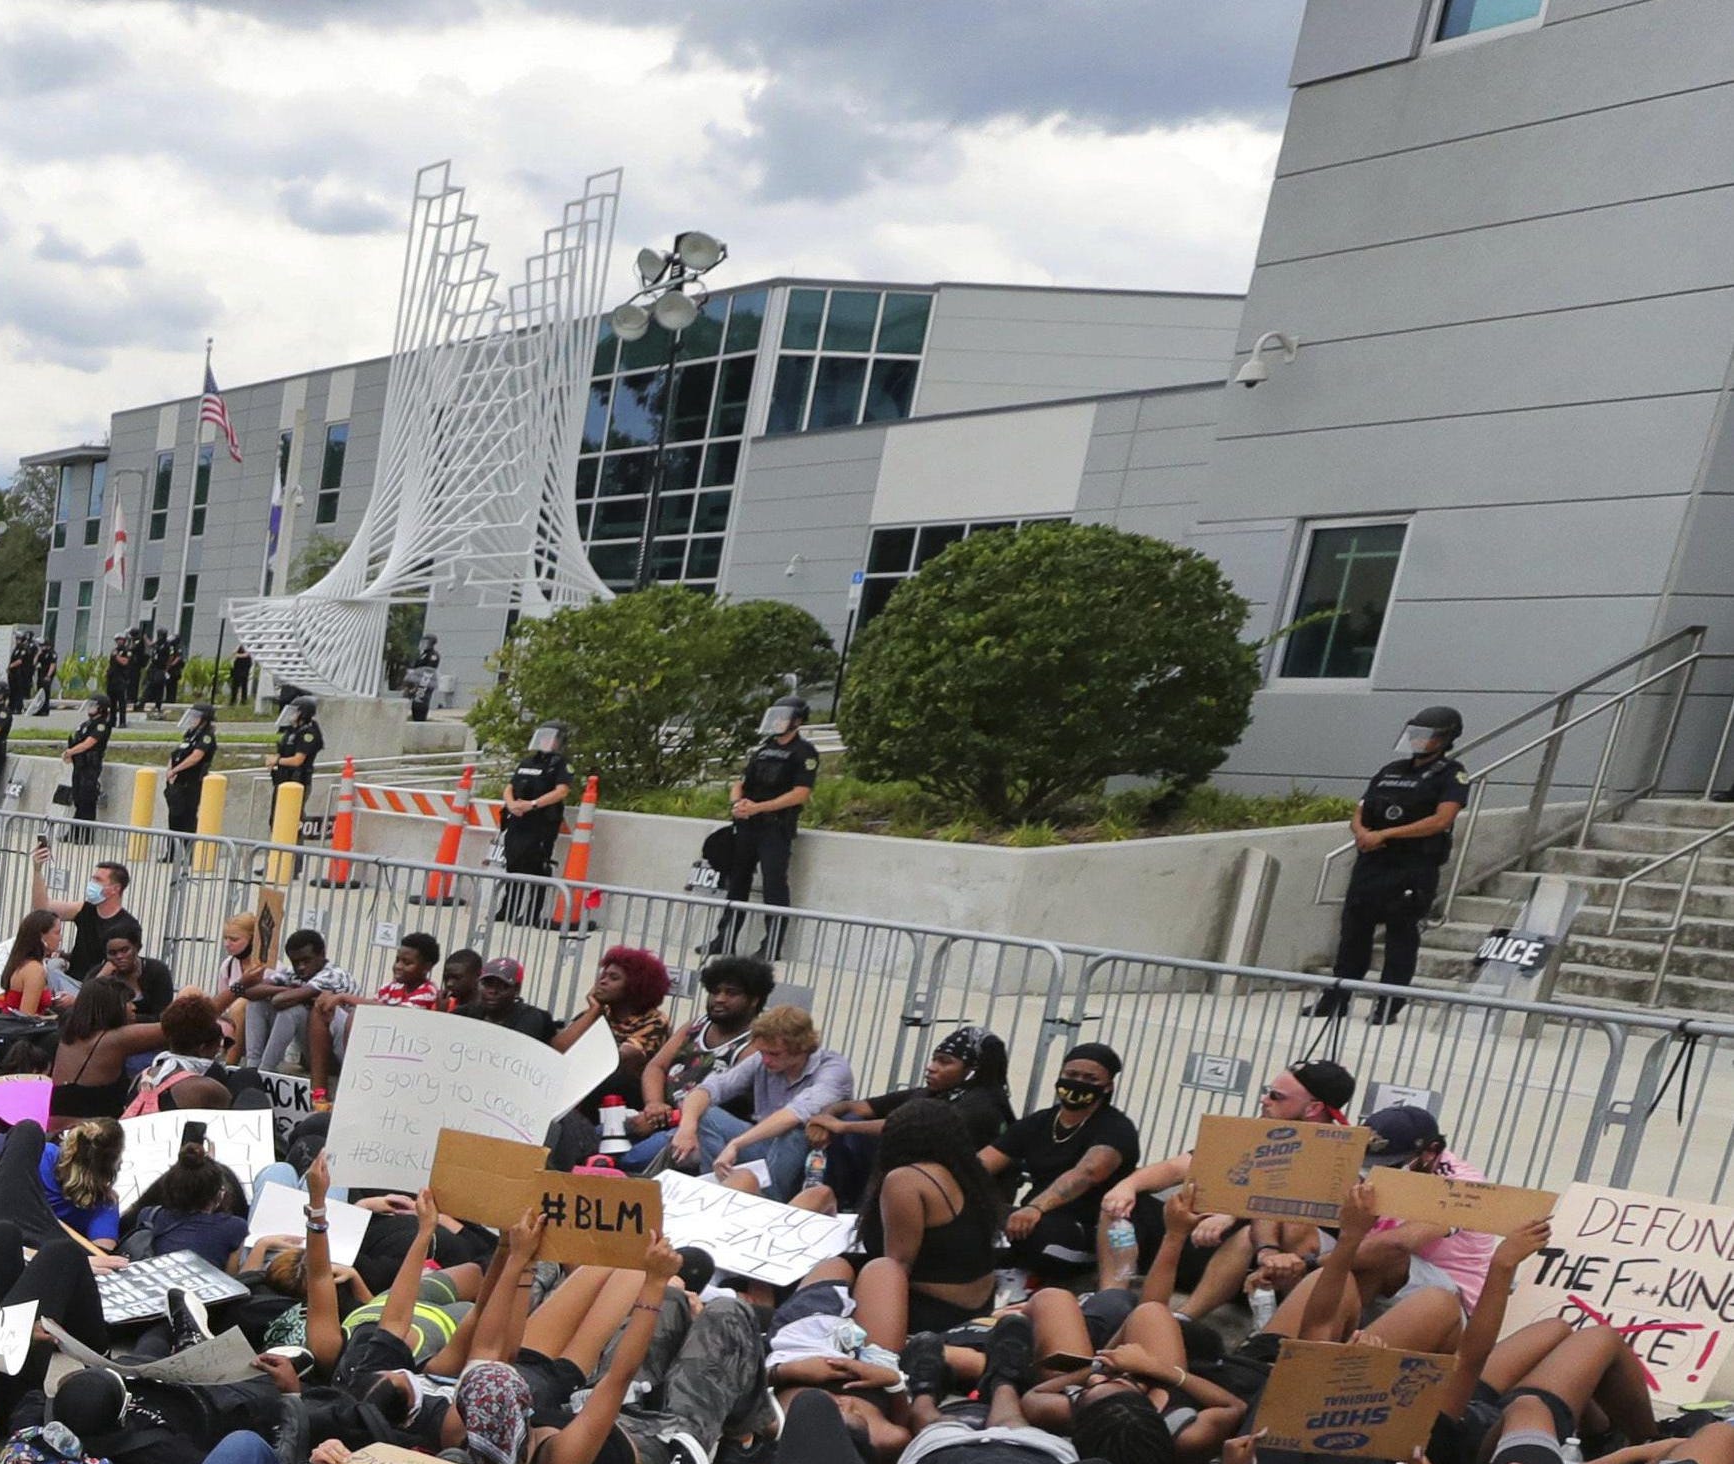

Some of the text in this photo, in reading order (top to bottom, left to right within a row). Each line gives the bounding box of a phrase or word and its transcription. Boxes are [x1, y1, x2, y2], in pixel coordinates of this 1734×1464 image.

[362, 1025, 432, 1055] This
[264, 1076, 312, 1112] ACK
[384, 1070, 441, 1105] going
[451, 1077, 473, 1103] to
[541, 1193, 644, 1235] #BLM
[1576, 1197, 1734, 1261] DEFUN
[1533, 1247, 1611, 1292] THE
[1323, 1391, 1390, 1408] ORIGINAL
[1306, 1406, 1392, 1431] SHOP
